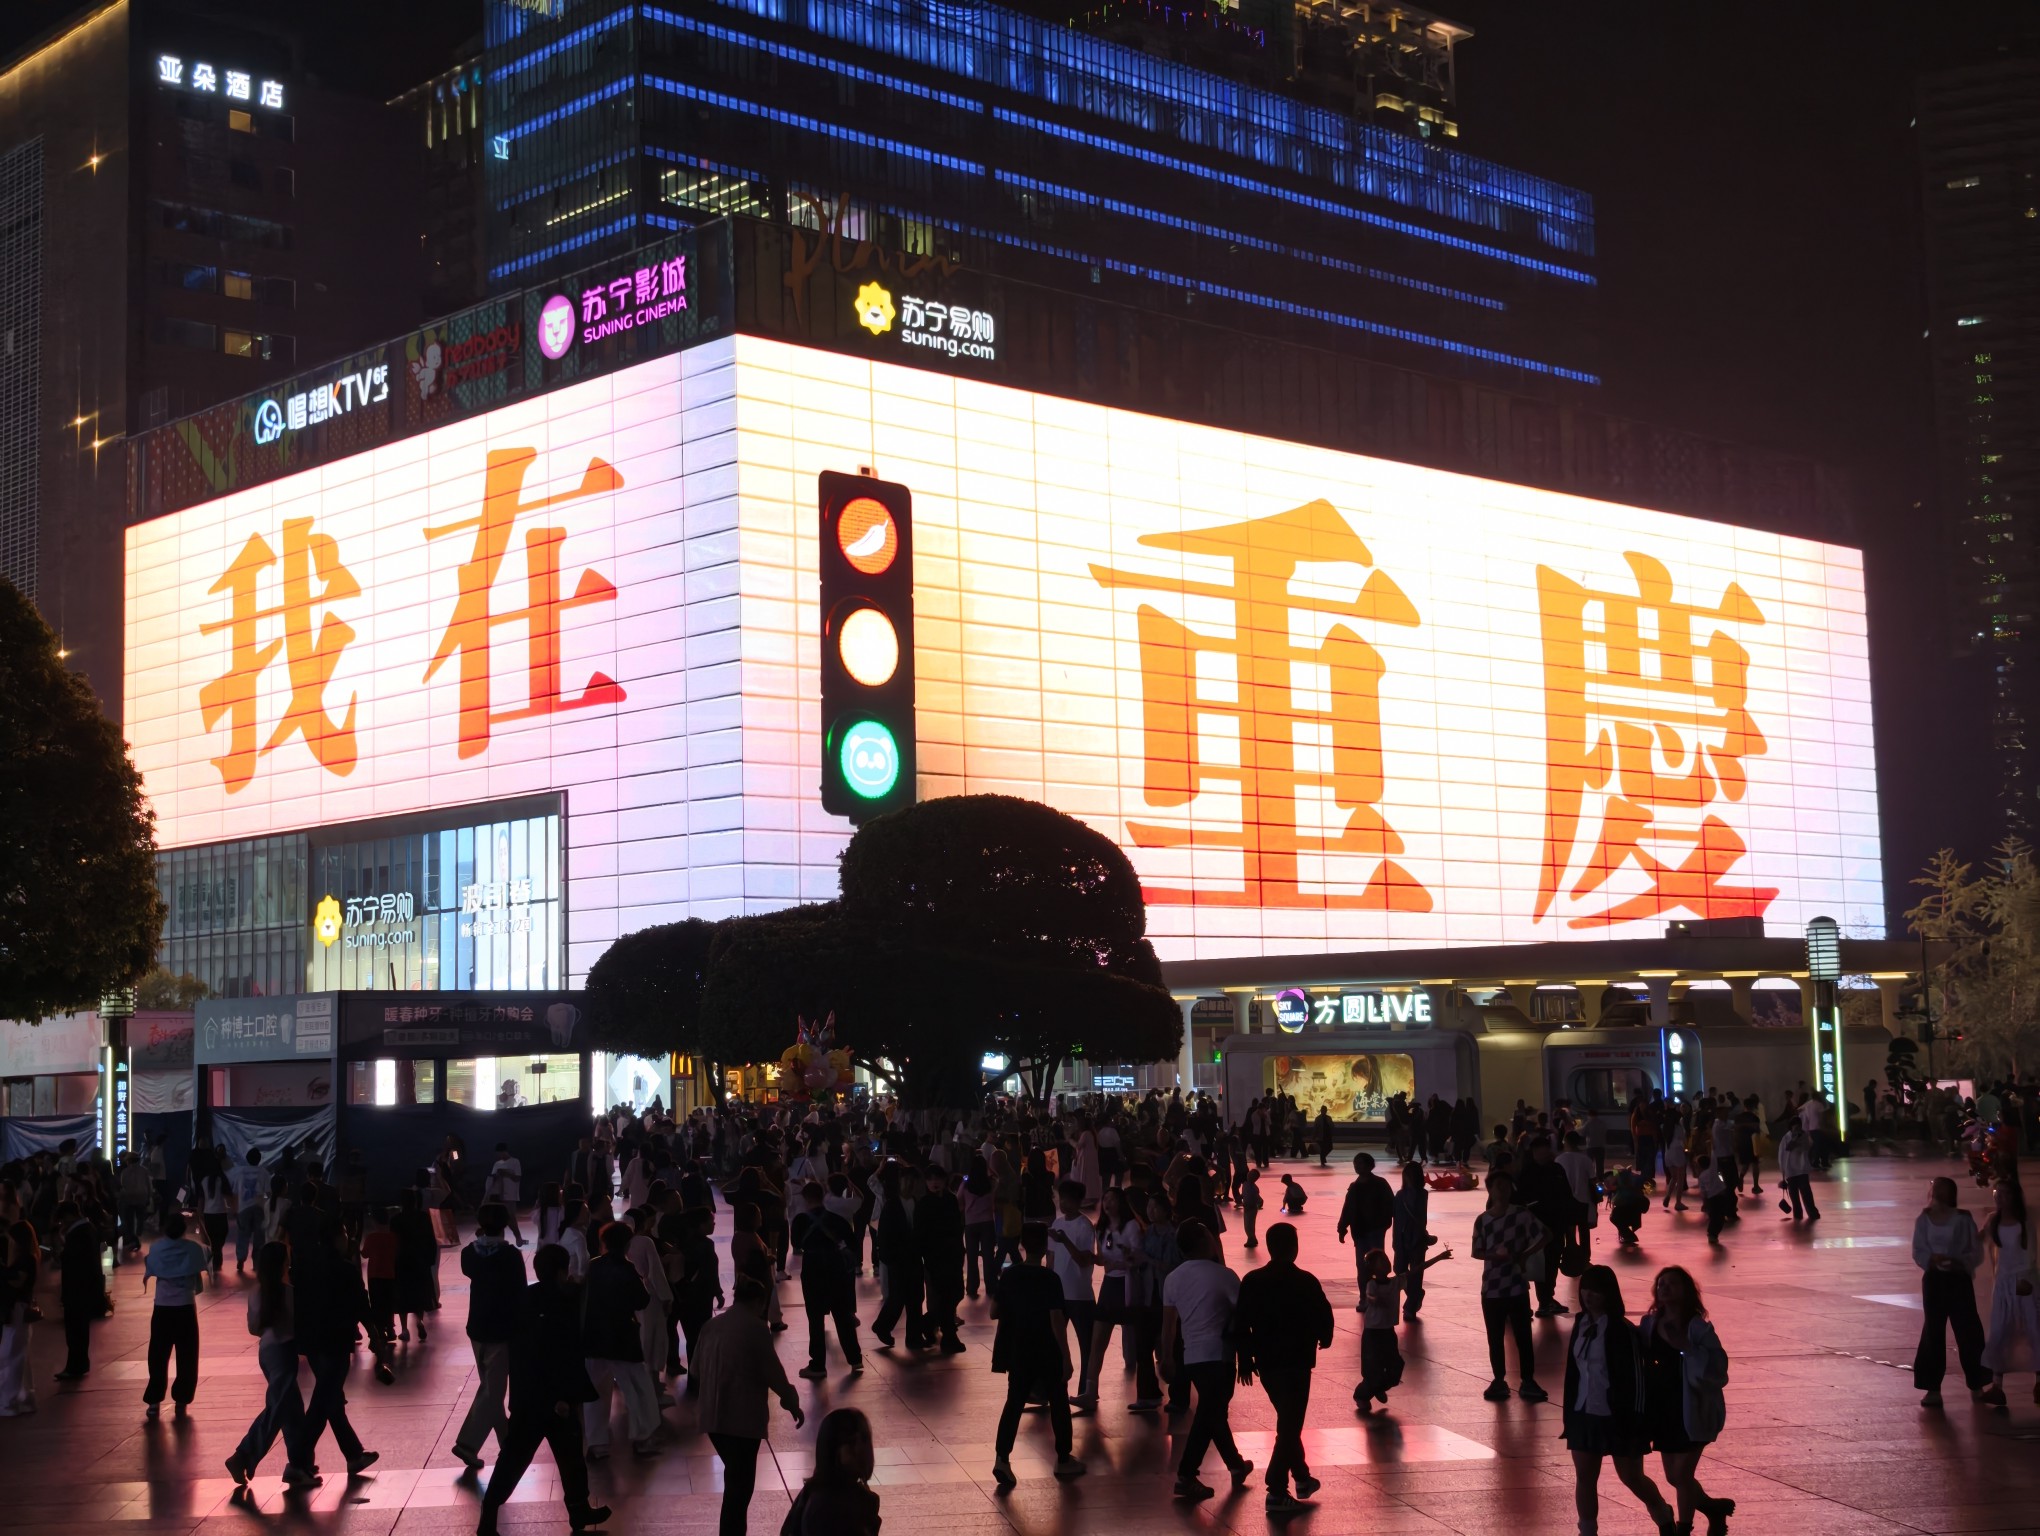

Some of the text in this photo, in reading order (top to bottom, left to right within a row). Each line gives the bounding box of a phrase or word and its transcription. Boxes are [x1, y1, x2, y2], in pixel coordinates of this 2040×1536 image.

[158, 54, 284, 109] 亚朵酒店
[582, 255, 686, 324] 苏宁影城
[583, 295, 688, 344] SUNING CINEMA
[901, 294, 995, 343] 苏宁易购
[444, 322, 520, 369] redbaby
[901, 328, 995, 361] suning.com
[373, 365, 389, 385] 6F
[199, 445, 628, 794] 我在
[345, 891, 414, 928] 苏宁易购
[345, 929, 413, 950] suning.com
[1277, 1000, 1292, 1010] SKY
[1279, 1011, 1305, 1023] SQUARE
[1314, 993, 1432, 1025] 方圆LIVE
